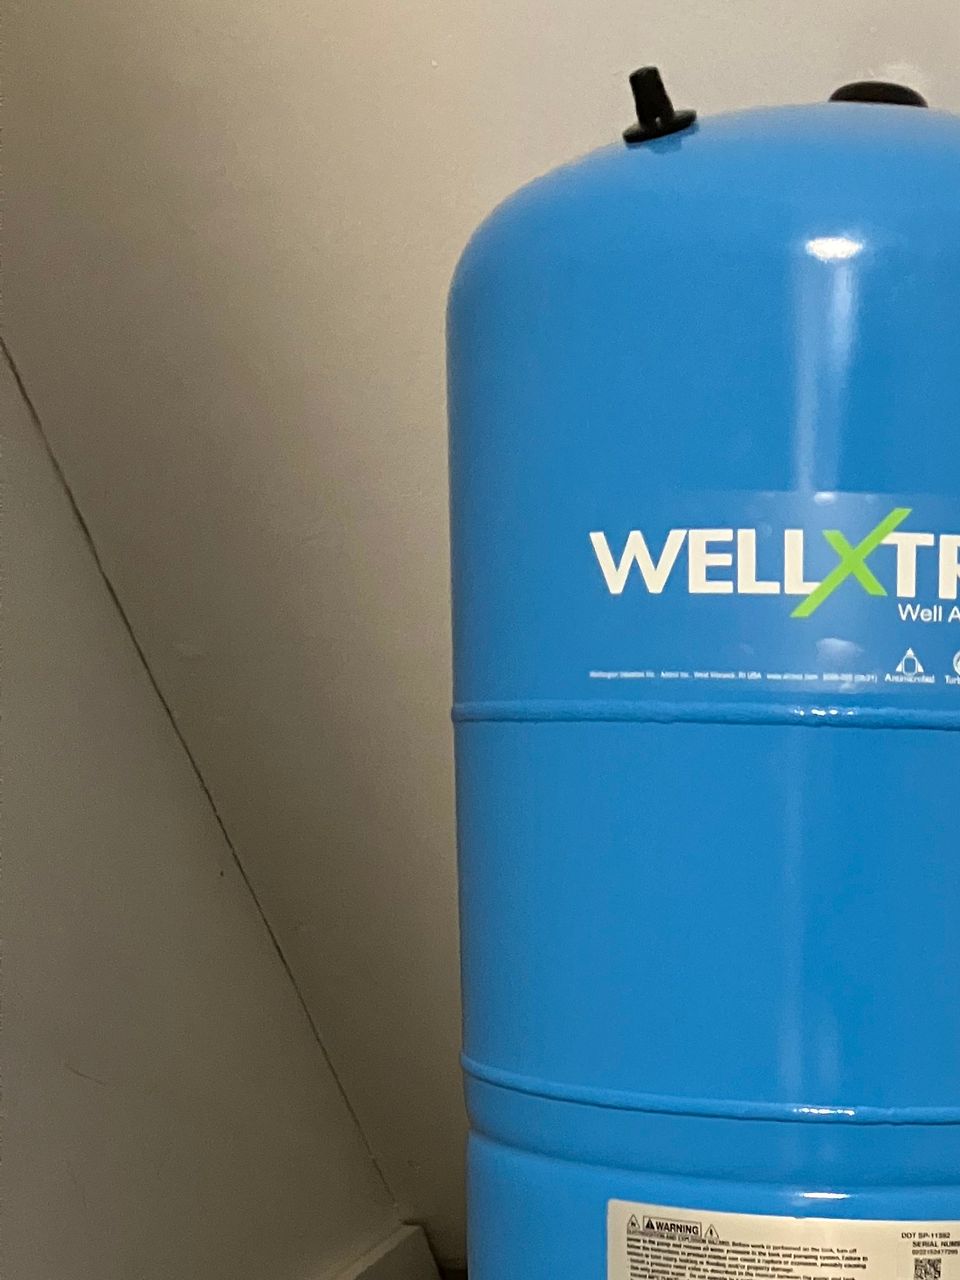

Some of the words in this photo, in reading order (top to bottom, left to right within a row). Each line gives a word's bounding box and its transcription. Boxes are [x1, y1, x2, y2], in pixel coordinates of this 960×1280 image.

[898, 603, 943, 622] Well
[655, 1220, 699, 1235] WARNING
[912, 1240, 938, 1248] SERIAL
